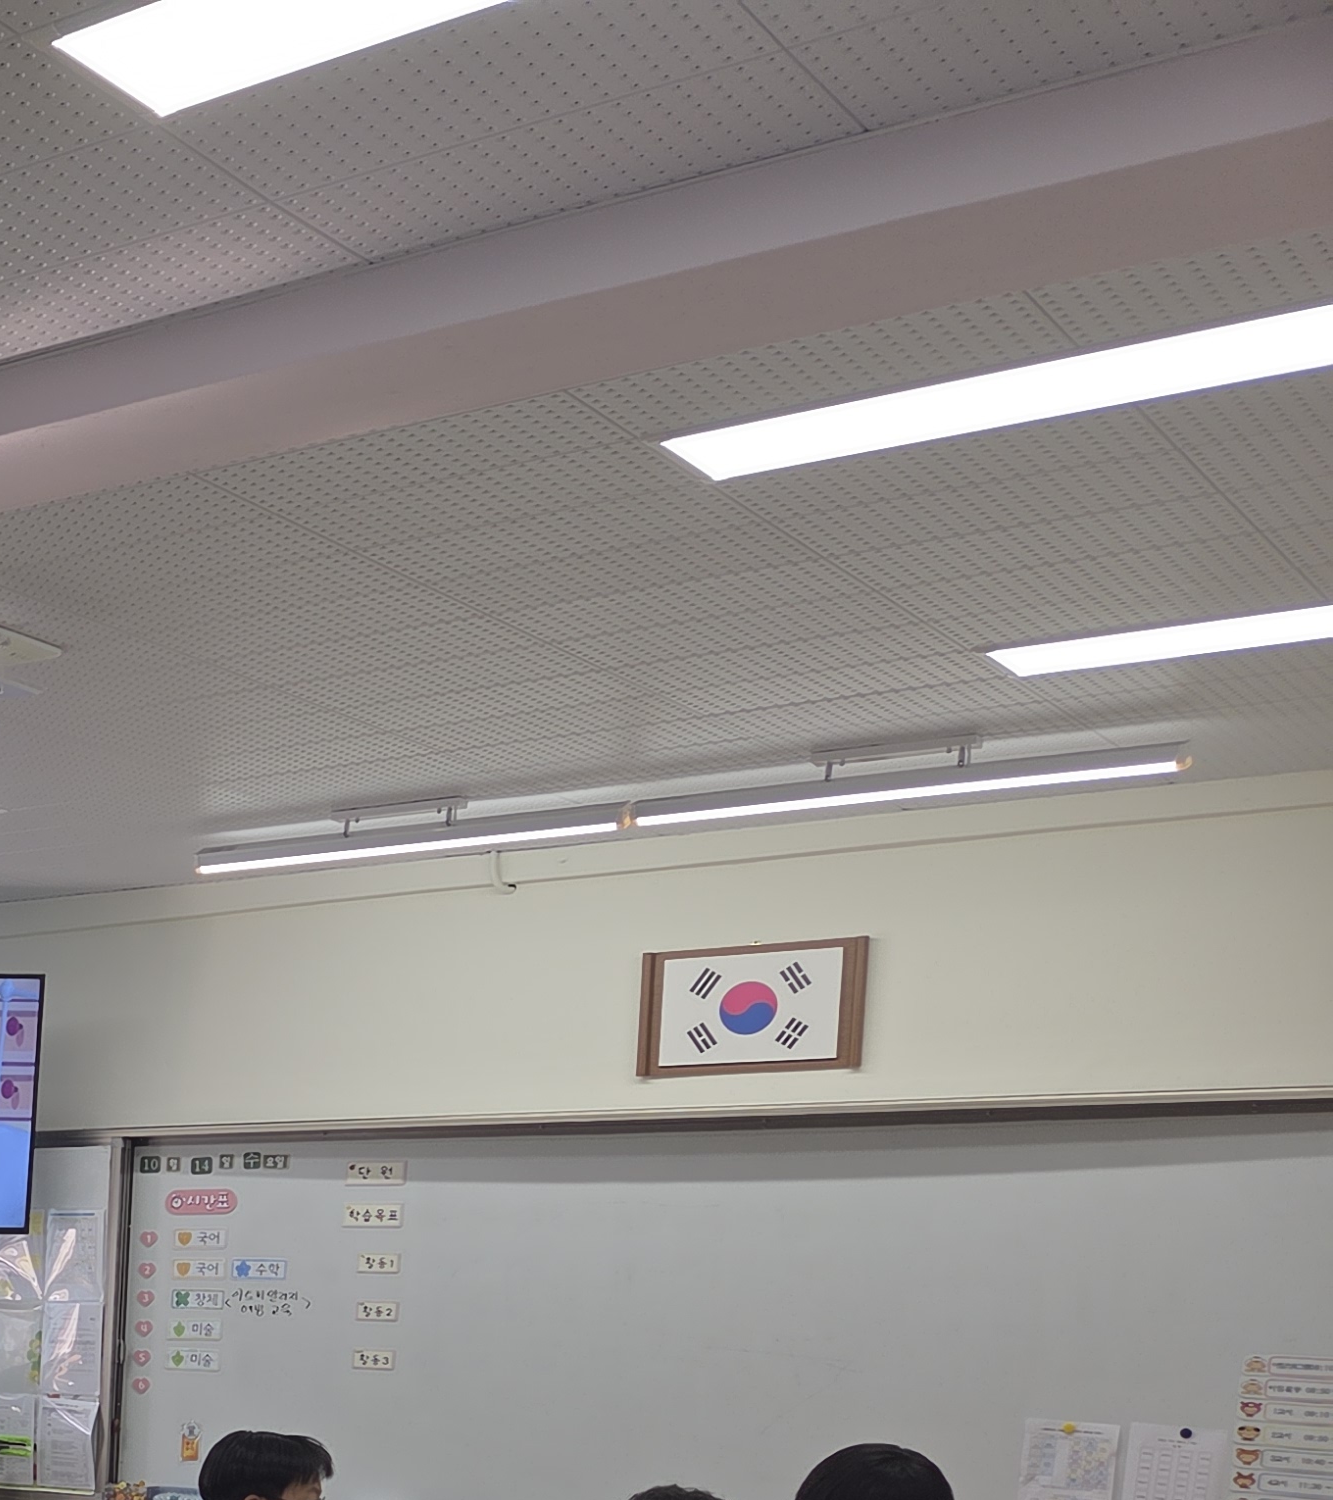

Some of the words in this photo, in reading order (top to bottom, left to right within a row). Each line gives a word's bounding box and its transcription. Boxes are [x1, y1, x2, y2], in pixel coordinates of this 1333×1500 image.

[143, 1160, 158, 1171] 10
[194, 1160, 210, 1172] 14
[186, 1191, 230, 1210] 시간표
[349, 1208, 399, 1223] 학습목표
[196, 1231, 221, 1246] 국어
[195, 1262, 220, 1276] 국어
[255, 1262, 281, 1277] 수학
[191, 1322, 215, 1337] 미술
[138, 1353, 146, 1363] 5
[189, 1353, 215, 1368] 미술
